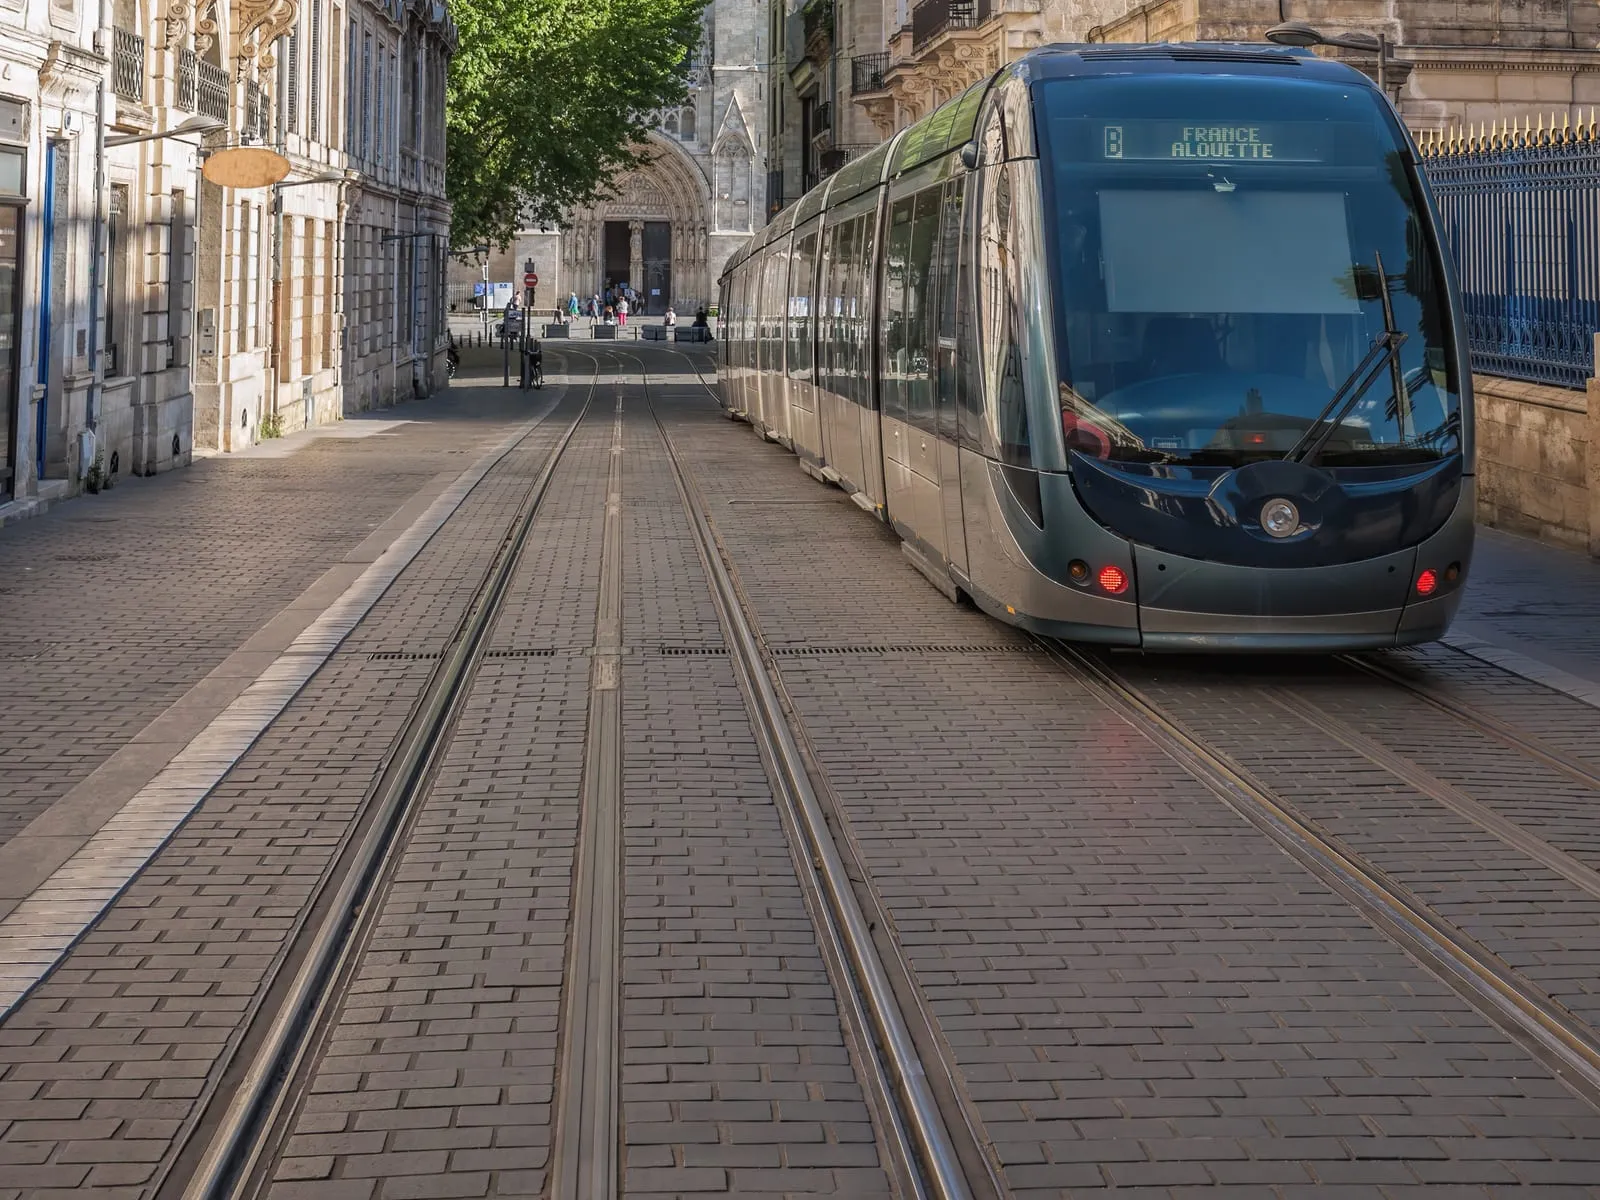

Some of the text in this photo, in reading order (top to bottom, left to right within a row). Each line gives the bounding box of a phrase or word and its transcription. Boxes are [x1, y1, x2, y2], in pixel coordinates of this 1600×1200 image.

[1105, 127, 1122, 157] B
[1183, 127, 1260, 142] FRANCE
[1171, 142, 1273, 158] ALOUETTE
